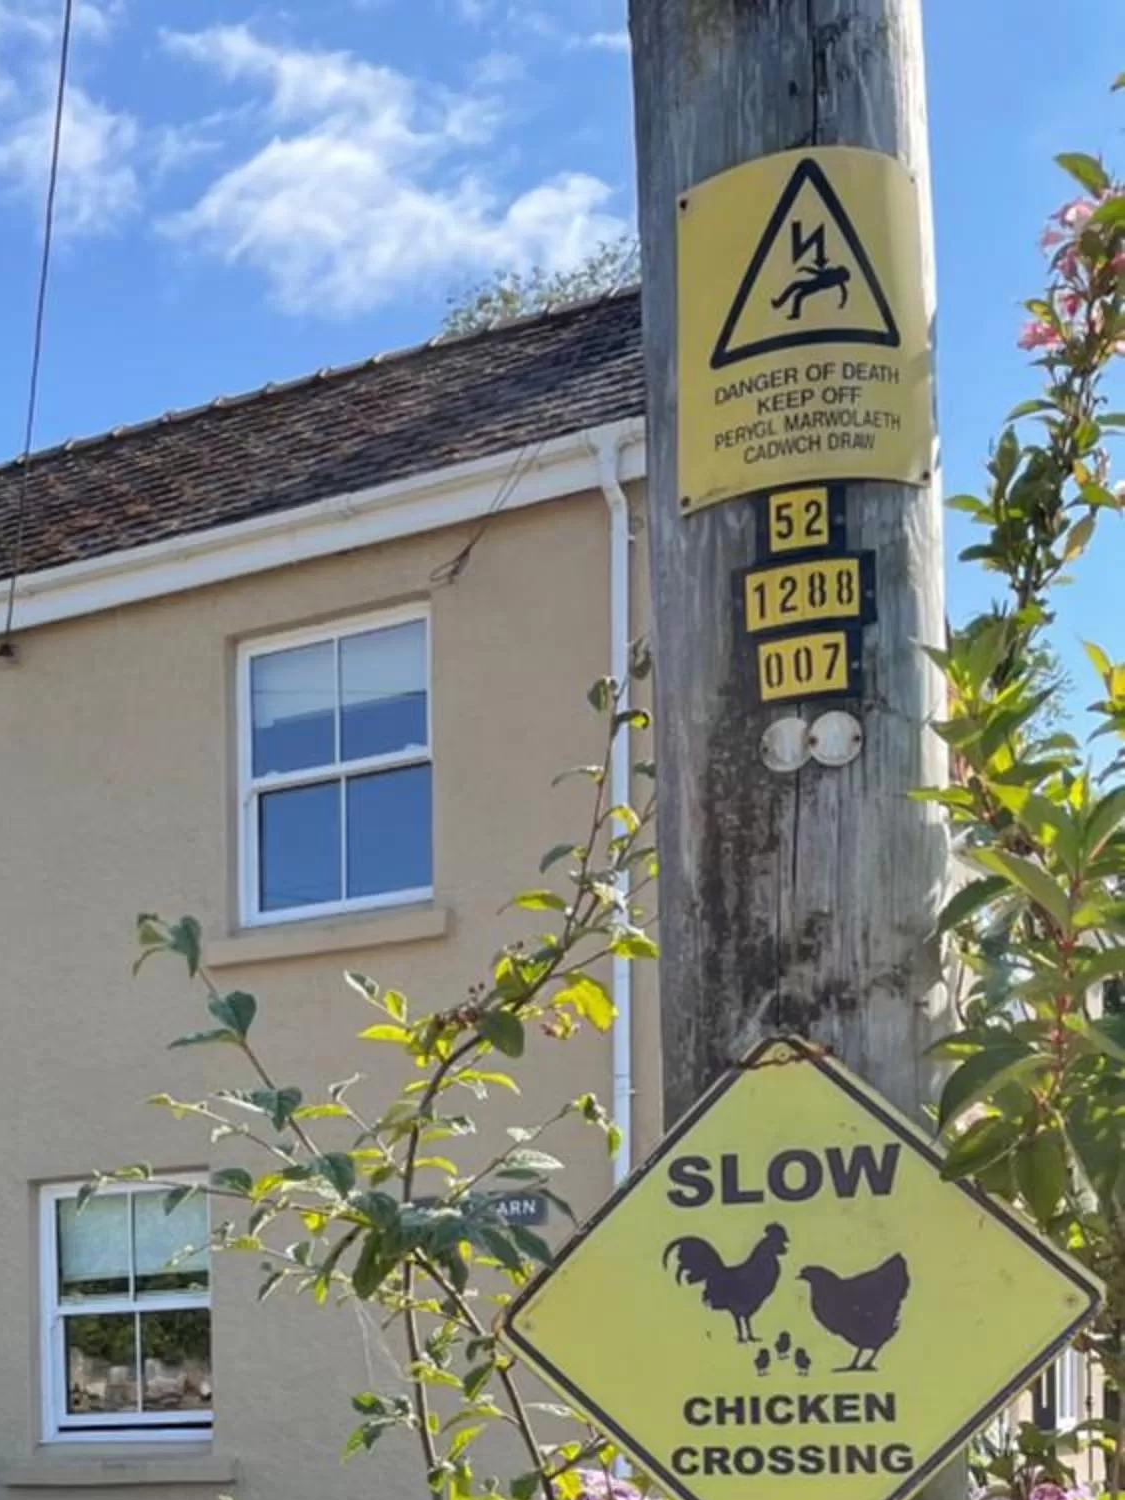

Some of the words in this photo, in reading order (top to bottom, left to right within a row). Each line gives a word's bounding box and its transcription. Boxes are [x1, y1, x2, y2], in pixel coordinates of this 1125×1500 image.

[714, 366, 798, 406] DANGER
[805, 362, 836, 383] OF
[842, 361, 900, 385] DEATH
[757, 387, 815, 416] KEEP
[821, 385, 863, 405] OFF
[714, 418, 778, 451] PERYGL
[783, 408, 901, 432] MARWOLAETH
[743, 434, 821, 465] CADWCH
[827, 431, 876, 451] DRAW
[775, 500, 824, 540] 52
[753, 570, 854, 619] 1288
[765, 642, 839, 689] 007
[666, 1143, 901, 1208] SLOW
[683, 1393, 896, 1426] CHICKEN
[671, 1443, 914, 1476] CROSSING
